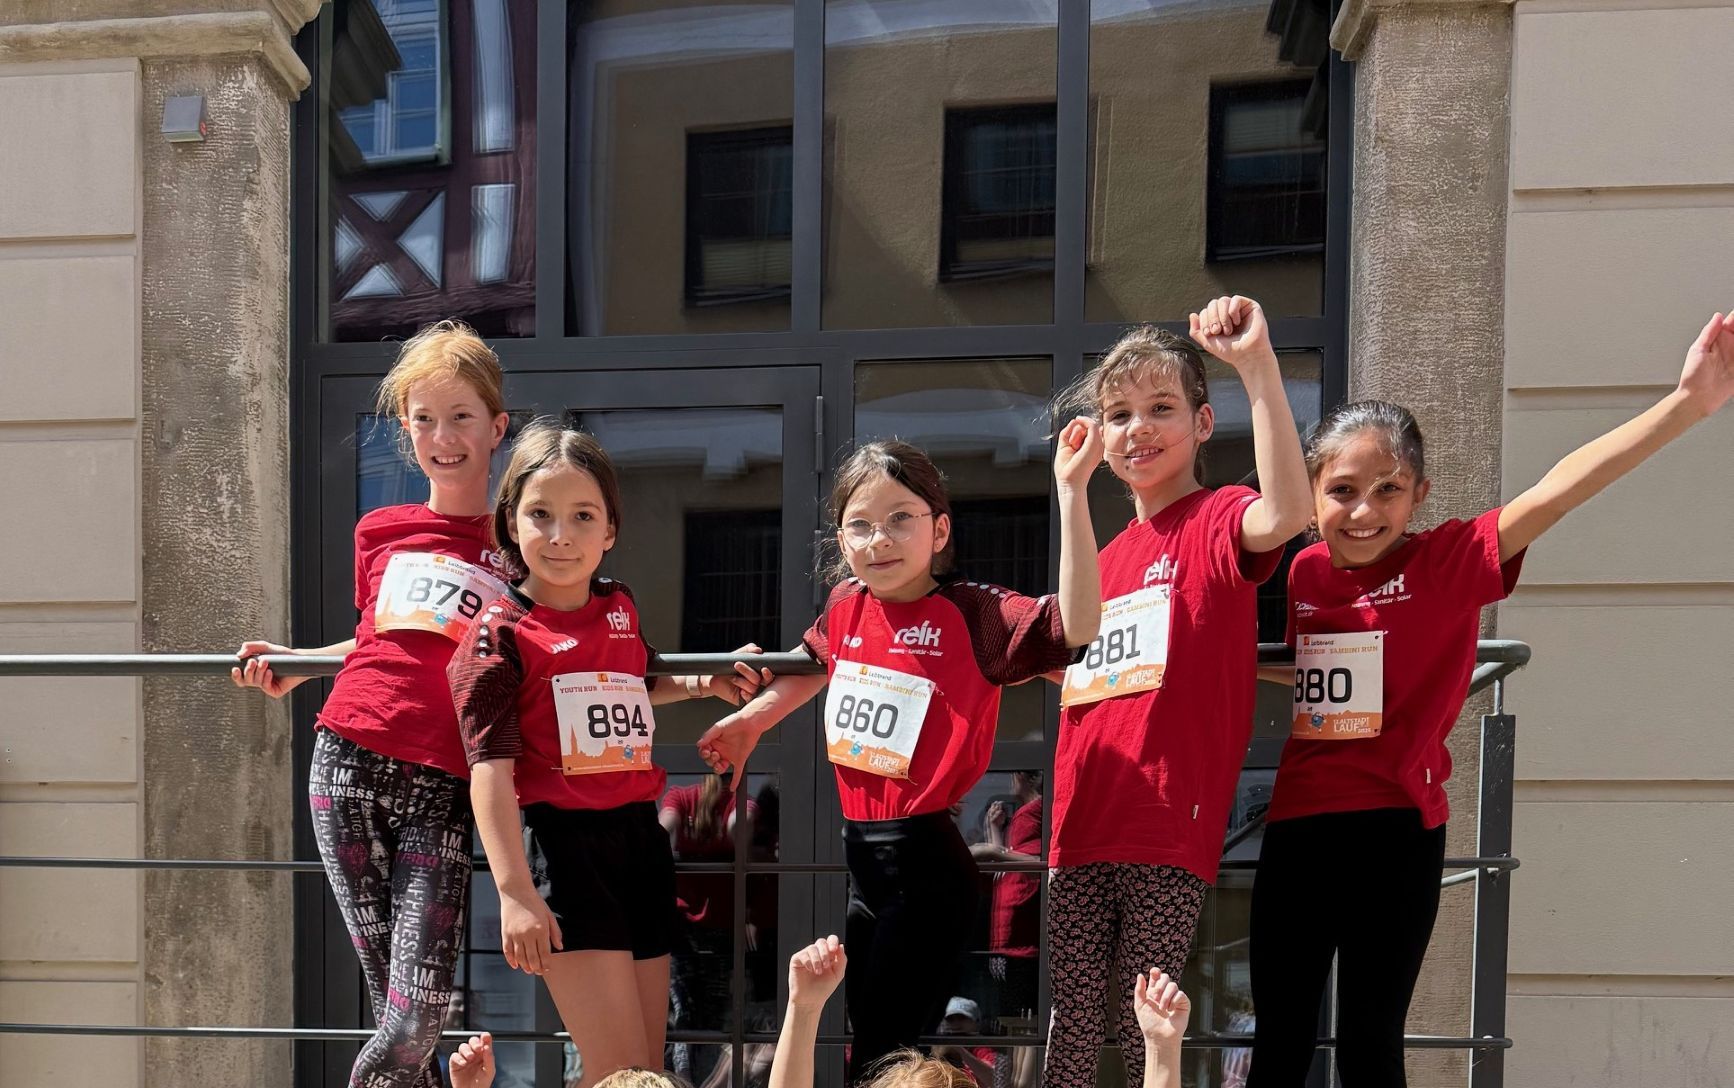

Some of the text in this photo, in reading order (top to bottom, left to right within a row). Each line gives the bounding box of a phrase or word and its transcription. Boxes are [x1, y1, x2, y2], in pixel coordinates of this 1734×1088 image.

[407, 577, 483, 621] 879
[550, 639, 579, 655] JAKO
[1086, 624, 1141, 670] 881
[1295, 667, 1353, 704] 880
[587, 704, 649, 739] 894
[836, 694, 899, 739] 860
[1334, 721, 1360, 733] LAUF
